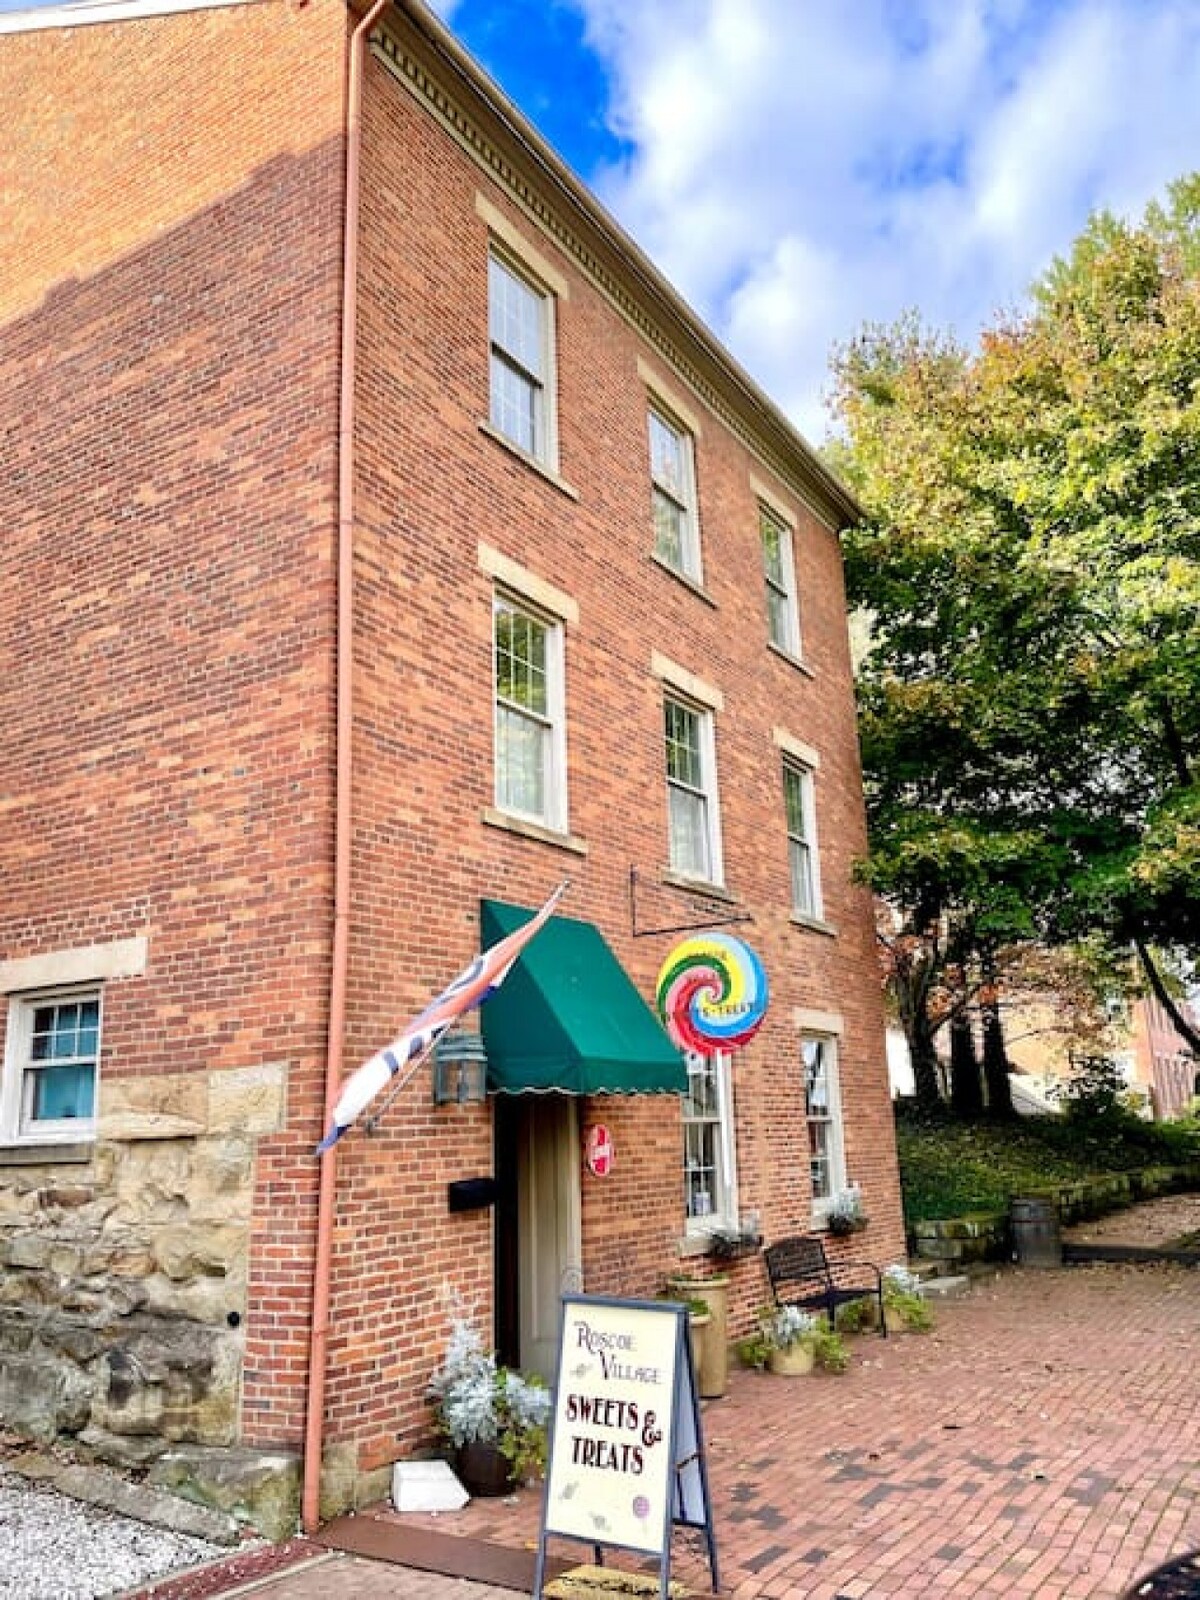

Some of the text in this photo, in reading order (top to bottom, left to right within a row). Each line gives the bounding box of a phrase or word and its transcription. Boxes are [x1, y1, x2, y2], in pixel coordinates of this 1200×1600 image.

[573, 1321, 637, 1354] ROSCOE
[598, 1349, 662, 1384] VILLAGE
[566, 1393, 663, 1447] SWEETS &
[572, 1435, 643, 1475] TREATS
